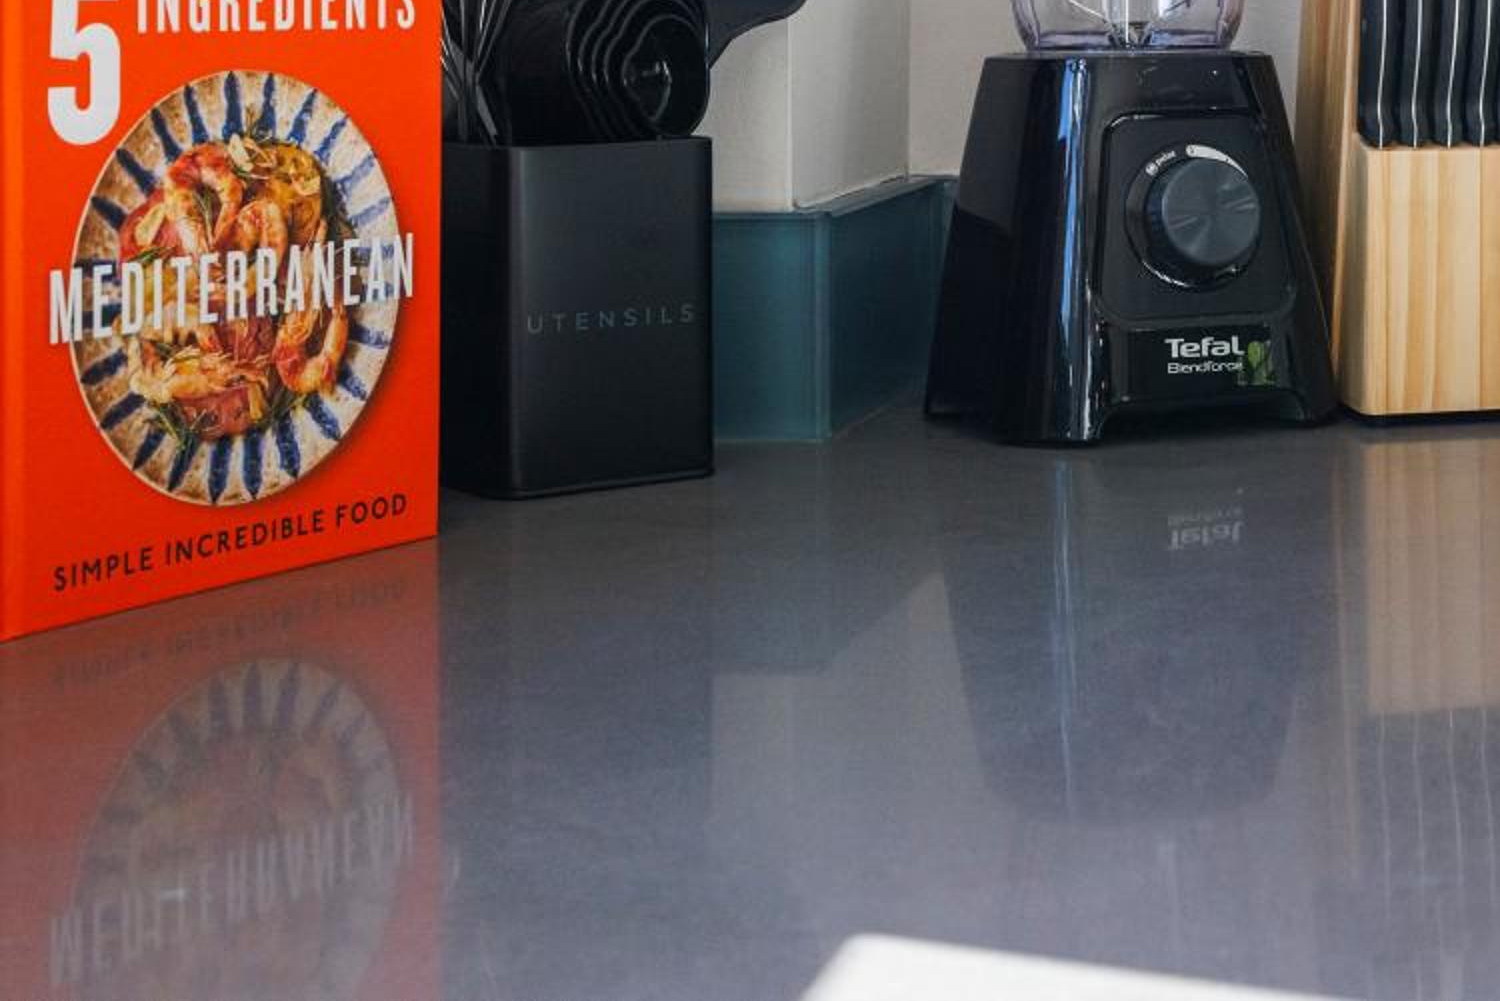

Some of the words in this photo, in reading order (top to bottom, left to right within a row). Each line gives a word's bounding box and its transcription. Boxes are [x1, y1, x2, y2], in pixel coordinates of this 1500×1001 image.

[49, 233, 415, 345] MEDITERRANEAN
[526, 302, 695, 335] UTENSILS
[1164, 335, 1245, 358] Tefal
[54, 547, 153, 592] SIMPLE
[165, 514, 325, 568] INCREDIBLE
[337, 492, 408, 528] FOOD
